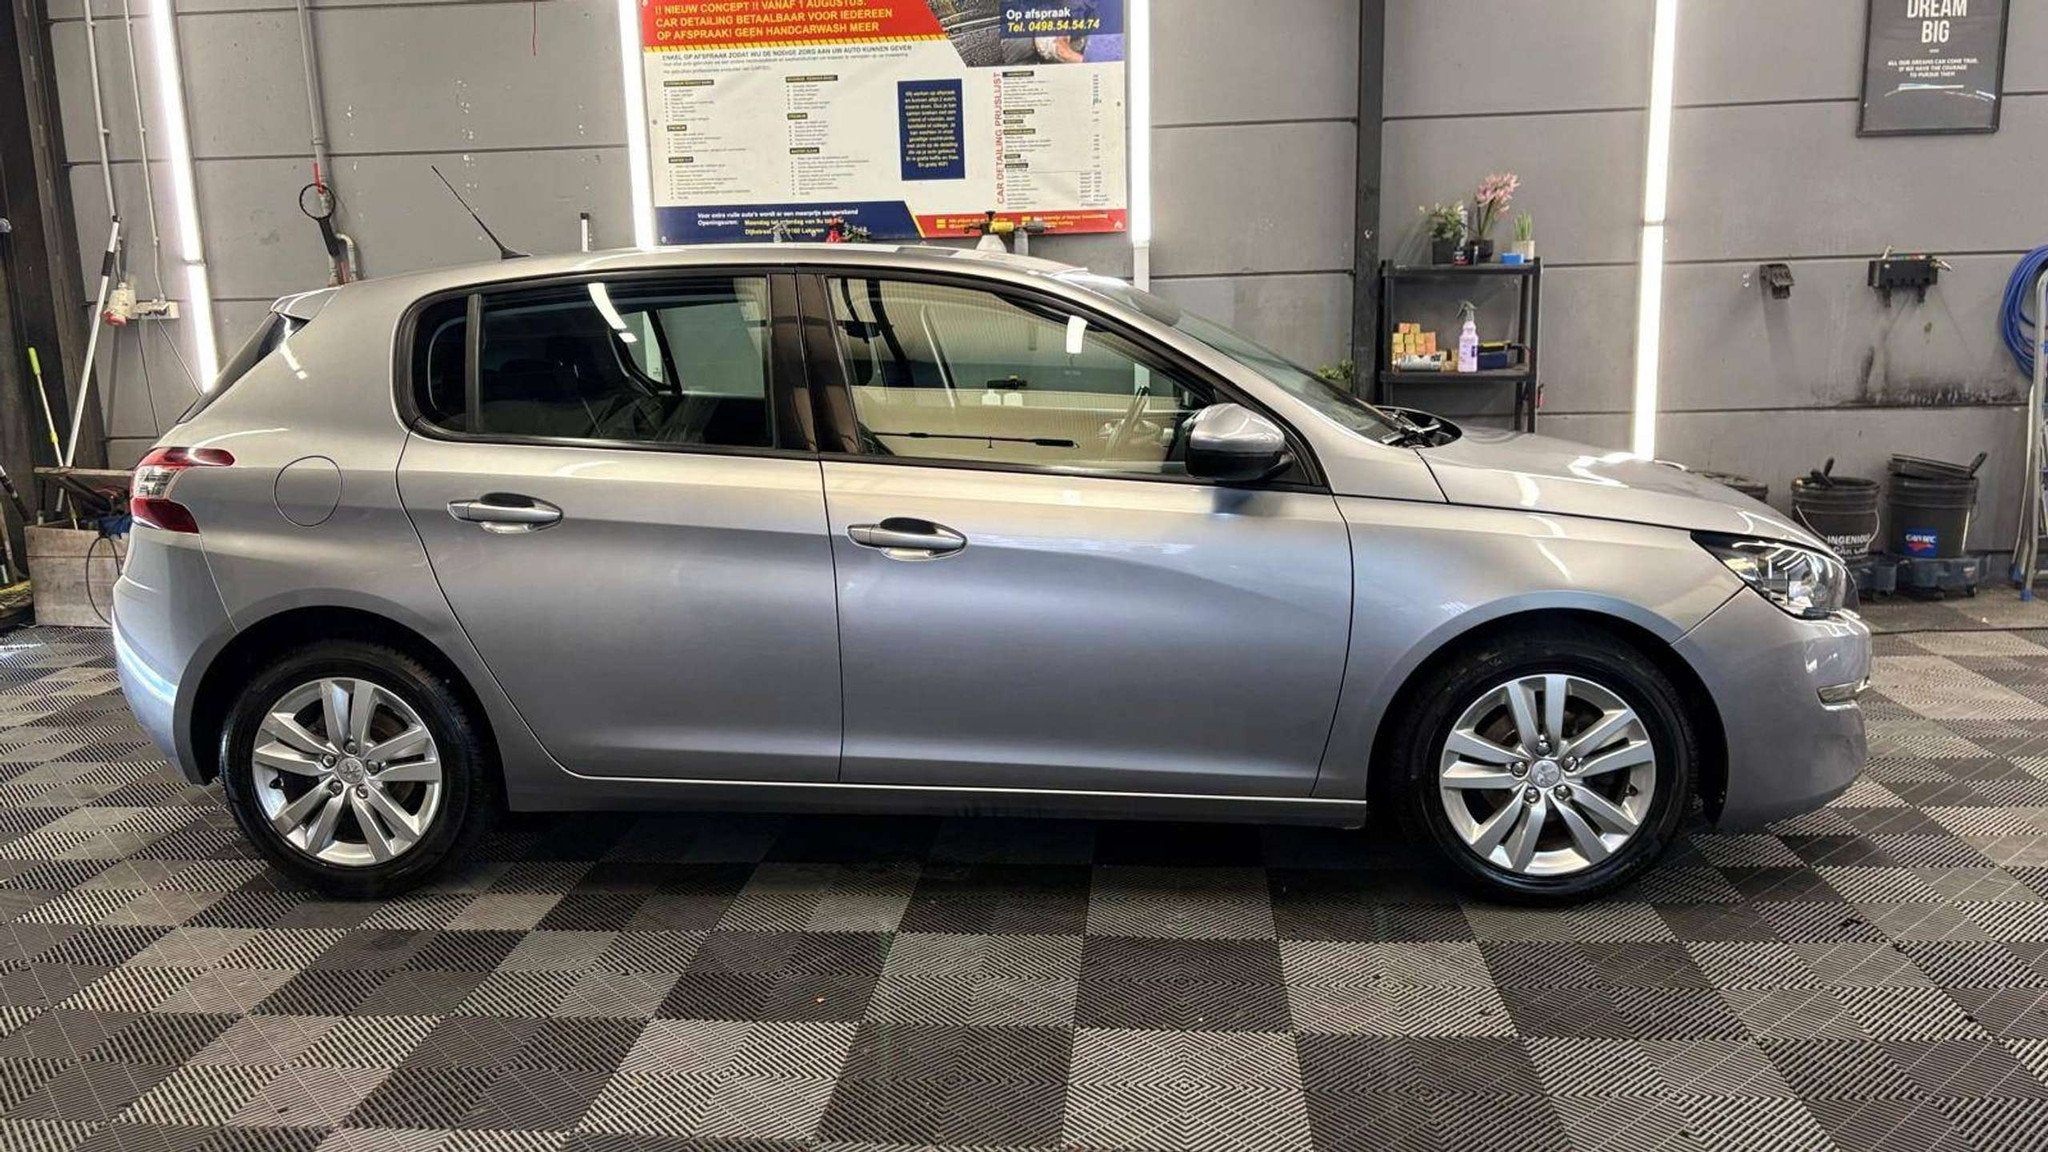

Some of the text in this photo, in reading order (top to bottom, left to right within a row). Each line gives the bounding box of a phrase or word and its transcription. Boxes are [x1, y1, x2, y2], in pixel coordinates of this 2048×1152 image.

[664, 4, 698, 14] NIEUW
[700, 2, 748, 13] CONCEPT
[762, 1, 796, 10] VANAF
[1006, 7, 1071, 21] Op afspraak
[1906, 0, 1968, 18] DREAM
[656, 8, 893, 28] CAR DETAILING BETAALBAAR VOOR IEDEREEN
[1008, 18, 1100, 32] Tel. 0498.54.54.74
[656, 22, 880, 41] OP AFSPRAAK! GEEN HANDCARWASH MEER
[1921, 20, 1950, 43] BIG
[993, 72, 1005, 204] CAR DETAILING PRIJSLIJST
